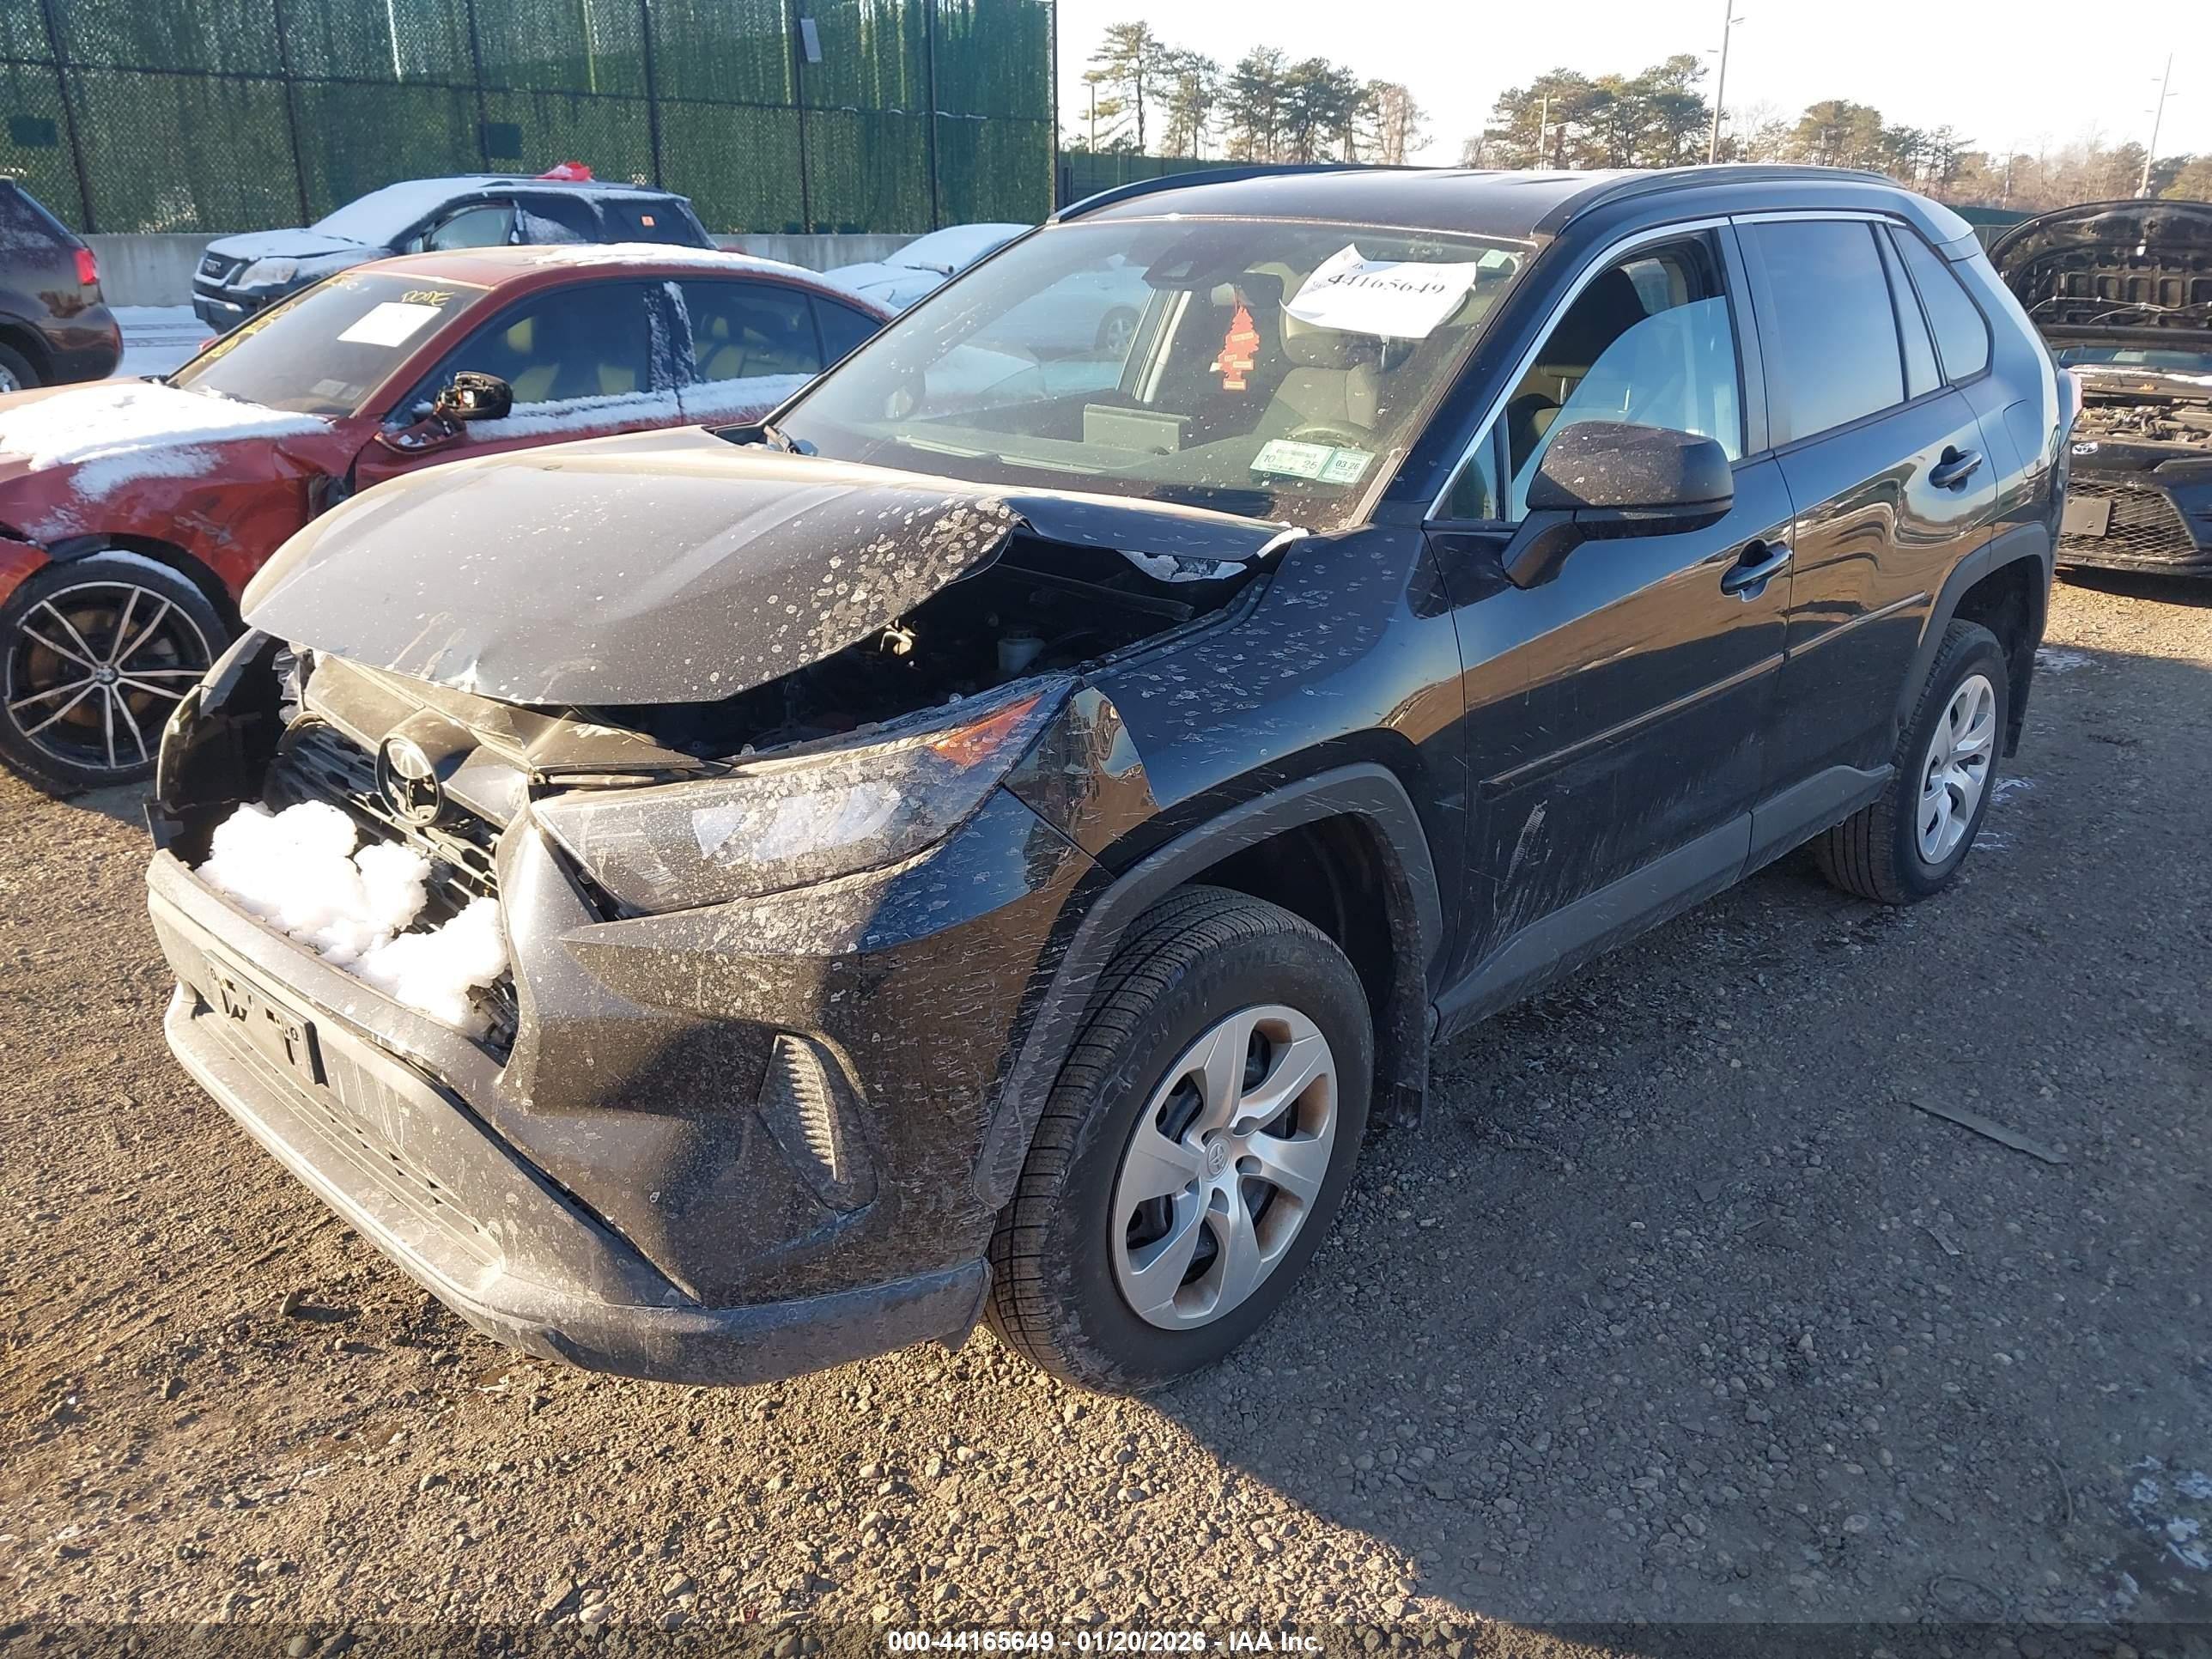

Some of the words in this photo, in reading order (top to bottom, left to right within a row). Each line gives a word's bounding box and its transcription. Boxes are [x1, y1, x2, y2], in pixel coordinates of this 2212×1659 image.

[1327, 272, 1446, 295] 44165649
[1263, 453, 1277, 464] 10
[1301, 459, 1318, 471] 25
[1334, 459, 1348, 468] 03
